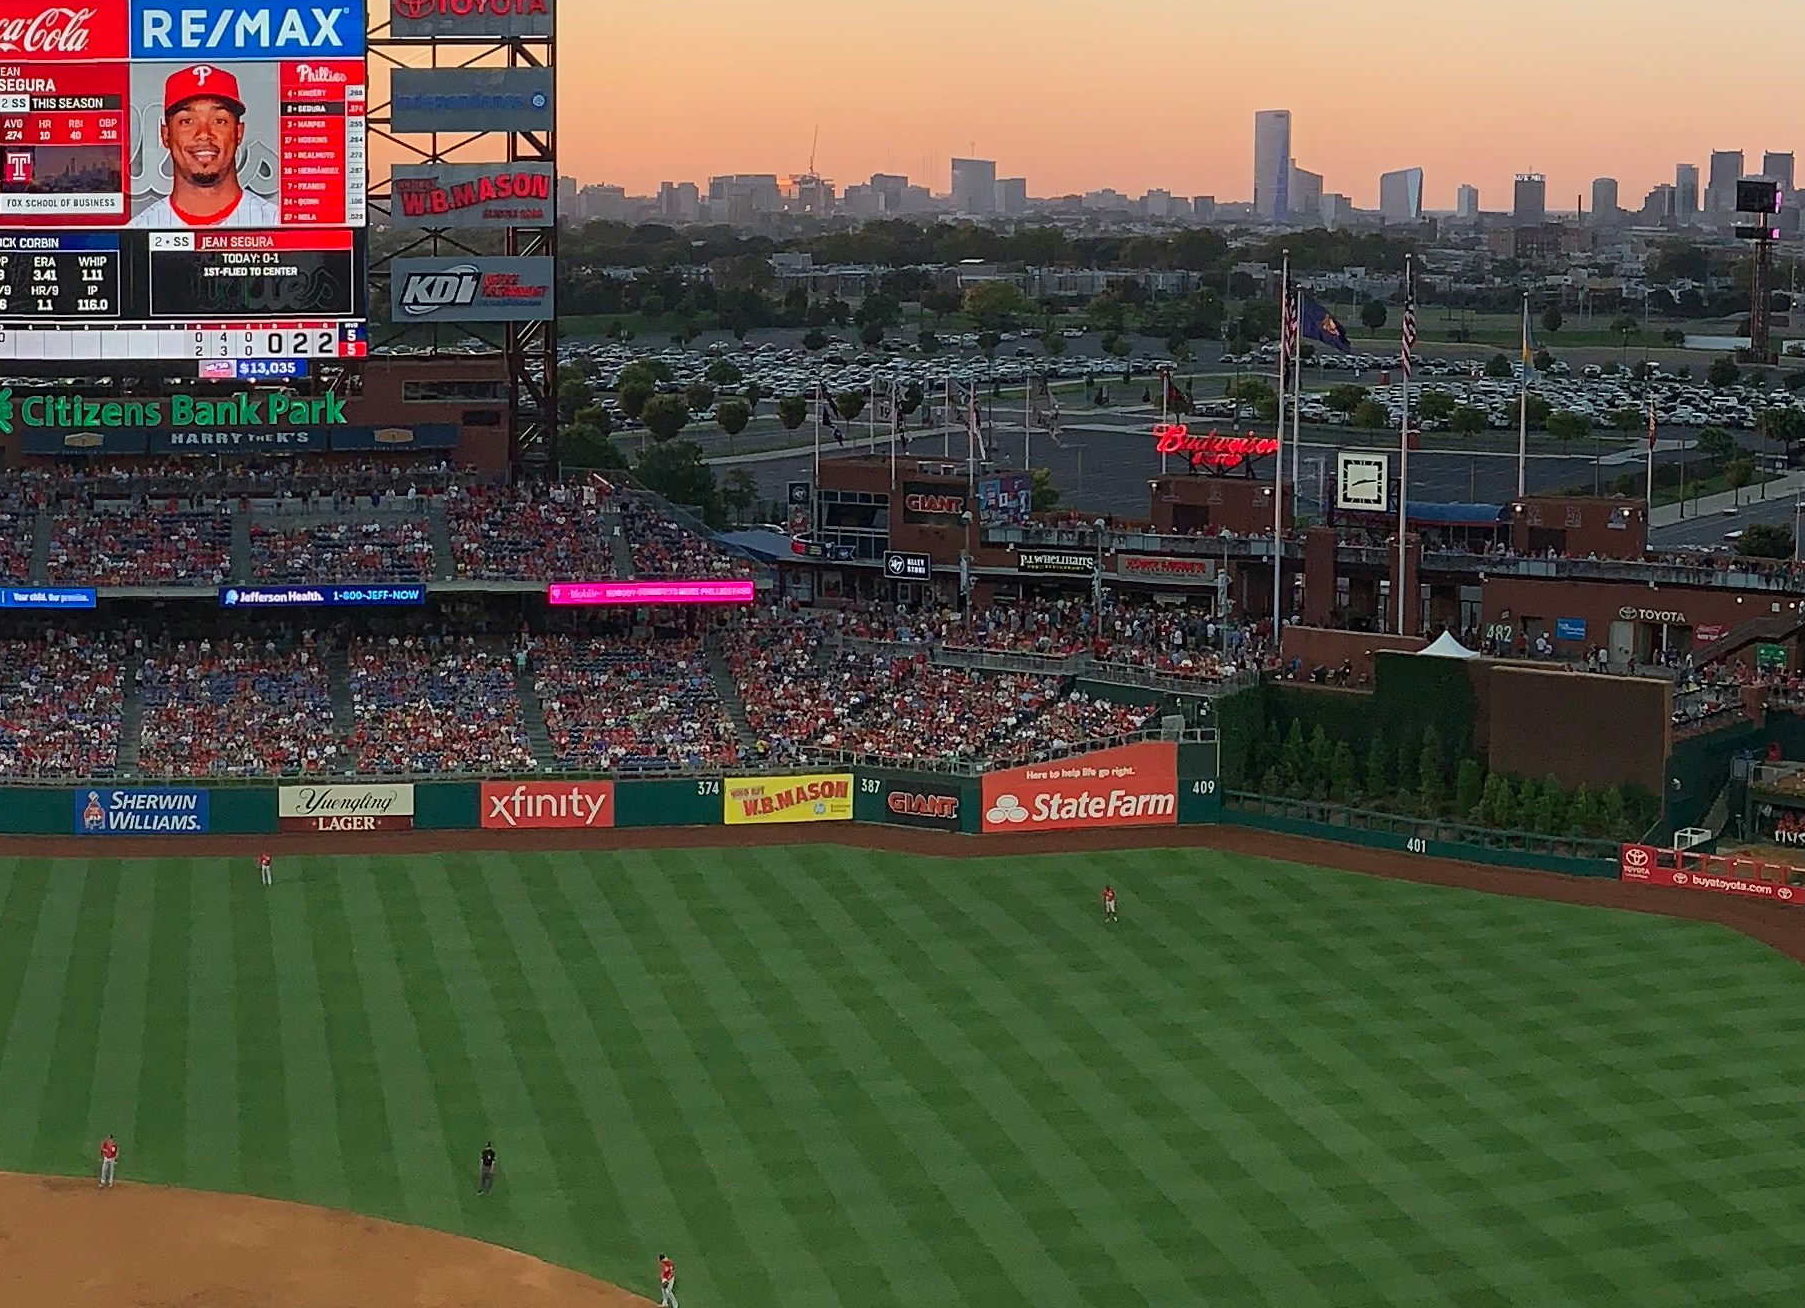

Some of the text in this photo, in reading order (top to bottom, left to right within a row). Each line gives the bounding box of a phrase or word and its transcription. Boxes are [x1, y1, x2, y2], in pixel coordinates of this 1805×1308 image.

[144, 9, 342, 47] RE/MAX
[297, 65, 347, 83] Phillies
[2, 99, 26, 108] 2 SS
[32, 98, 103, 108] THIS SEASON
[4, 119, 23, 128] AVG
[99, 119, 117, 127] OBP
[5, 131, 22, 140] .274
[7, 199, 115, 207] FOX SCHOOL OF BUSINESS
[20, 238, 59, 248] CORBIN
[155, 237, 189, 246] 2 SS
[201, 236, 274, 249] JEAN SEGURA
[34, 257, 55, 266] ERA
[78, 257, 106, 266] WHIP
[223, 253, 279, 263] TODAY: 0-1
[33, 270, 57, 280] 3.41
[82, 270, 103, 280] 1.11
[250, 267, 260, 276] TO
[263, 267, 297, 276] CENTER
[31, 286, 59, 295] HR/9
[88, 286, 98, 295] IP
[400, 273, 481, 305] KDI
[37, 300, 53, 310] 1.1
[77, 300, 108, 310] 116.0
[268, 333, 282, 353] 0
[294, 333, 307, 353] 2
[319, 333, 333, 353] 2
[239, 363, 295, 374] $13,035
[22, 392, 347, 427] Citizens Bank Park
[171, 433, 242, 445] HARRY
[276, 431, 308, 443] K'S
[240, 591, 324, 602] Jefferson Health.
[333, 590, 419, 600] 1-800-JEFF-NOW
[1639, 609, 1686, 623] TOYOTA
[1487, 625, 1512, 642] 482
[1027, 766, 1135, 779] Here to help life go right.
[697, 782, 719, 795] 374
[861, 778, 880, 793] 387
[1193, 781, 1215, 794] 409
[110, 791, 197, 810] SHERWIN
[296, 786, 398, 816] Yuengling
[489, 785, 606, 826] xfinity
[888, 791, 957, 819] GIANT
[317, 816, 377, 831] LAGER
[1407, 838, 1426, 853] 401
[1692, 875, 1772, 894] buyatoyota.com
